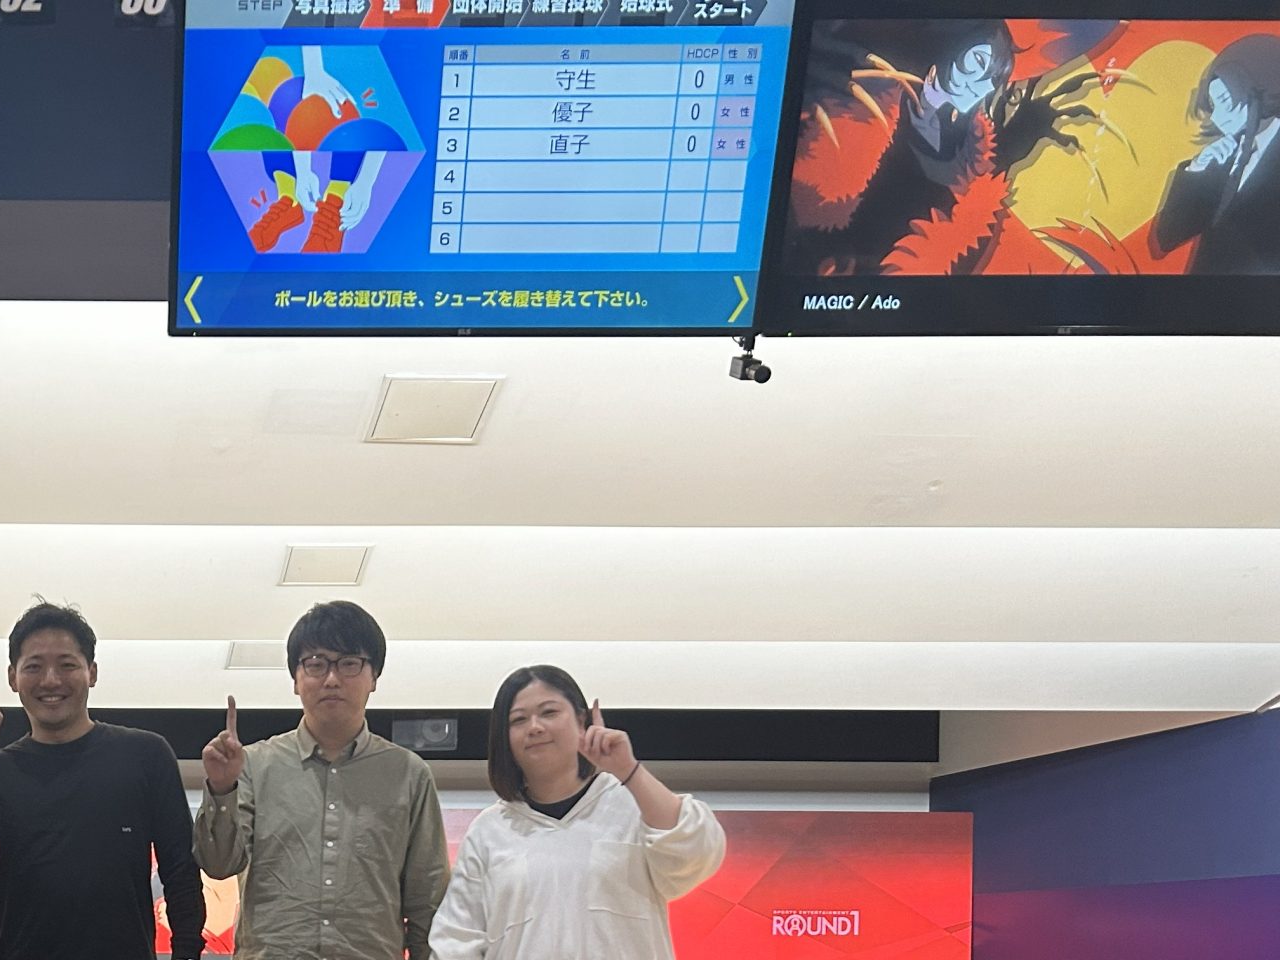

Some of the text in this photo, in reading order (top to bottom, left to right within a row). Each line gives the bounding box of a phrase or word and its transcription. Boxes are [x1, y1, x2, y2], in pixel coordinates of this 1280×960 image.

[238, 0, 283, 10] STEP
[295, 0, 366, 14] 写真撮影
[693, 2, 753, 19] スタート
[448, 48, 758, 61] 順番 名前 HDCP 性別
[453, 69, 755, 92] 1 守生 0 男性
[448, 101, 751, 123] 2 優子 0 女性
[446, 133, 746, 155] 3 直子 0 女性
[443, 169, 456, 184] 4
[441, 201, 453, 216] 5
[439, 232, 451, 247] 6
[274, 289, 650, 309] ボールをお選び頂き、シューズを履き替えて下さい。
[803, 294, 901, 310] MAGIC / Ado
[772, 911, 860, 937] ROUND1
